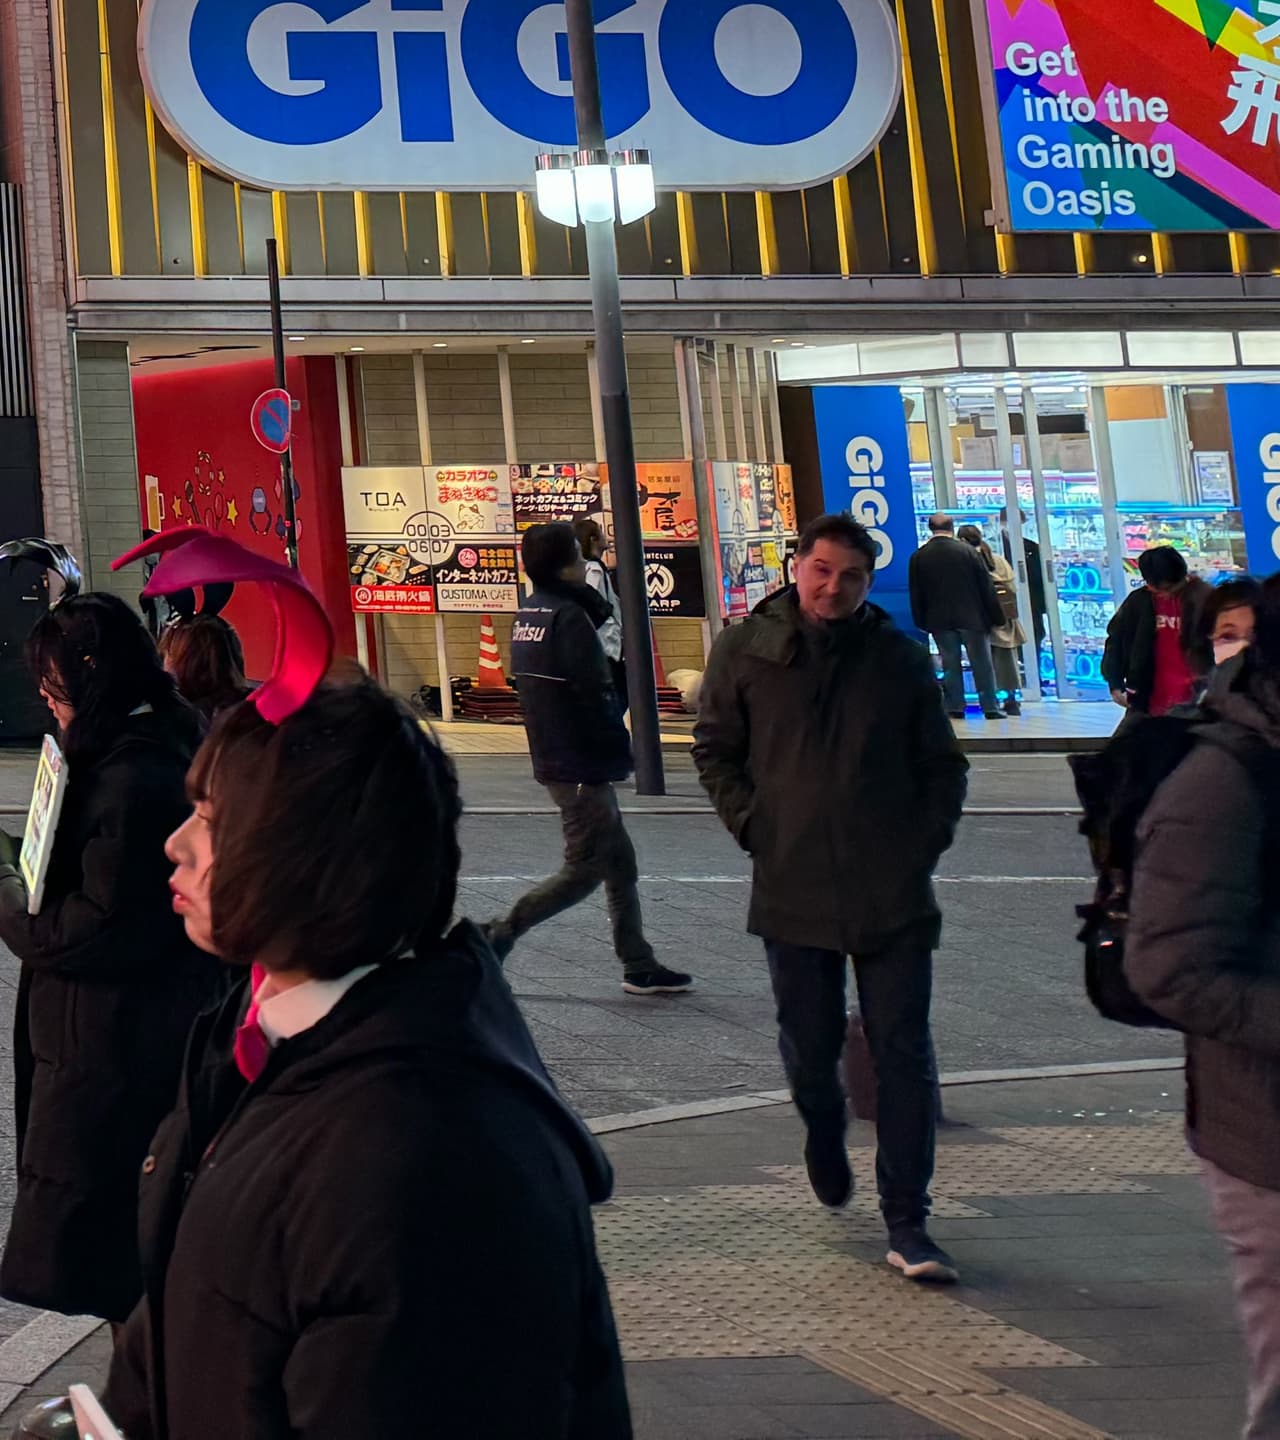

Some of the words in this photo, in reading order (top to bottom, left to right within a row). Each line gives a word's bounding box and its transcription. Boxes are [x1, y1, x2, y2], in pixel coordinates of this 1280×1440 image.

[1005, 42, 1078, 77] Get
[1023, 89, 1096, 123] into
[1105, 89, 1169, 123] the
[1017, 135, 1177, 178] Gaming
[1023, 181, 1136, 216] Oasis
[446, 470, 489, 481] カラオケ
[360, 492, 407, 506] TOA
[438, 485, 499, 504] まねきねこ
[845, 436, 894, 571] GiGO
[406, 524, 427, 537] 00
[430, 524, 451, 537] 03
[408, 541, 428, 553] 06
[431, 541, 450, 553] 07
[436, 570, 517, 583] インターネットカフェ
[441, 589, 488, 599] CUSTOMA
[490, 589, 514, 600] CAFE
